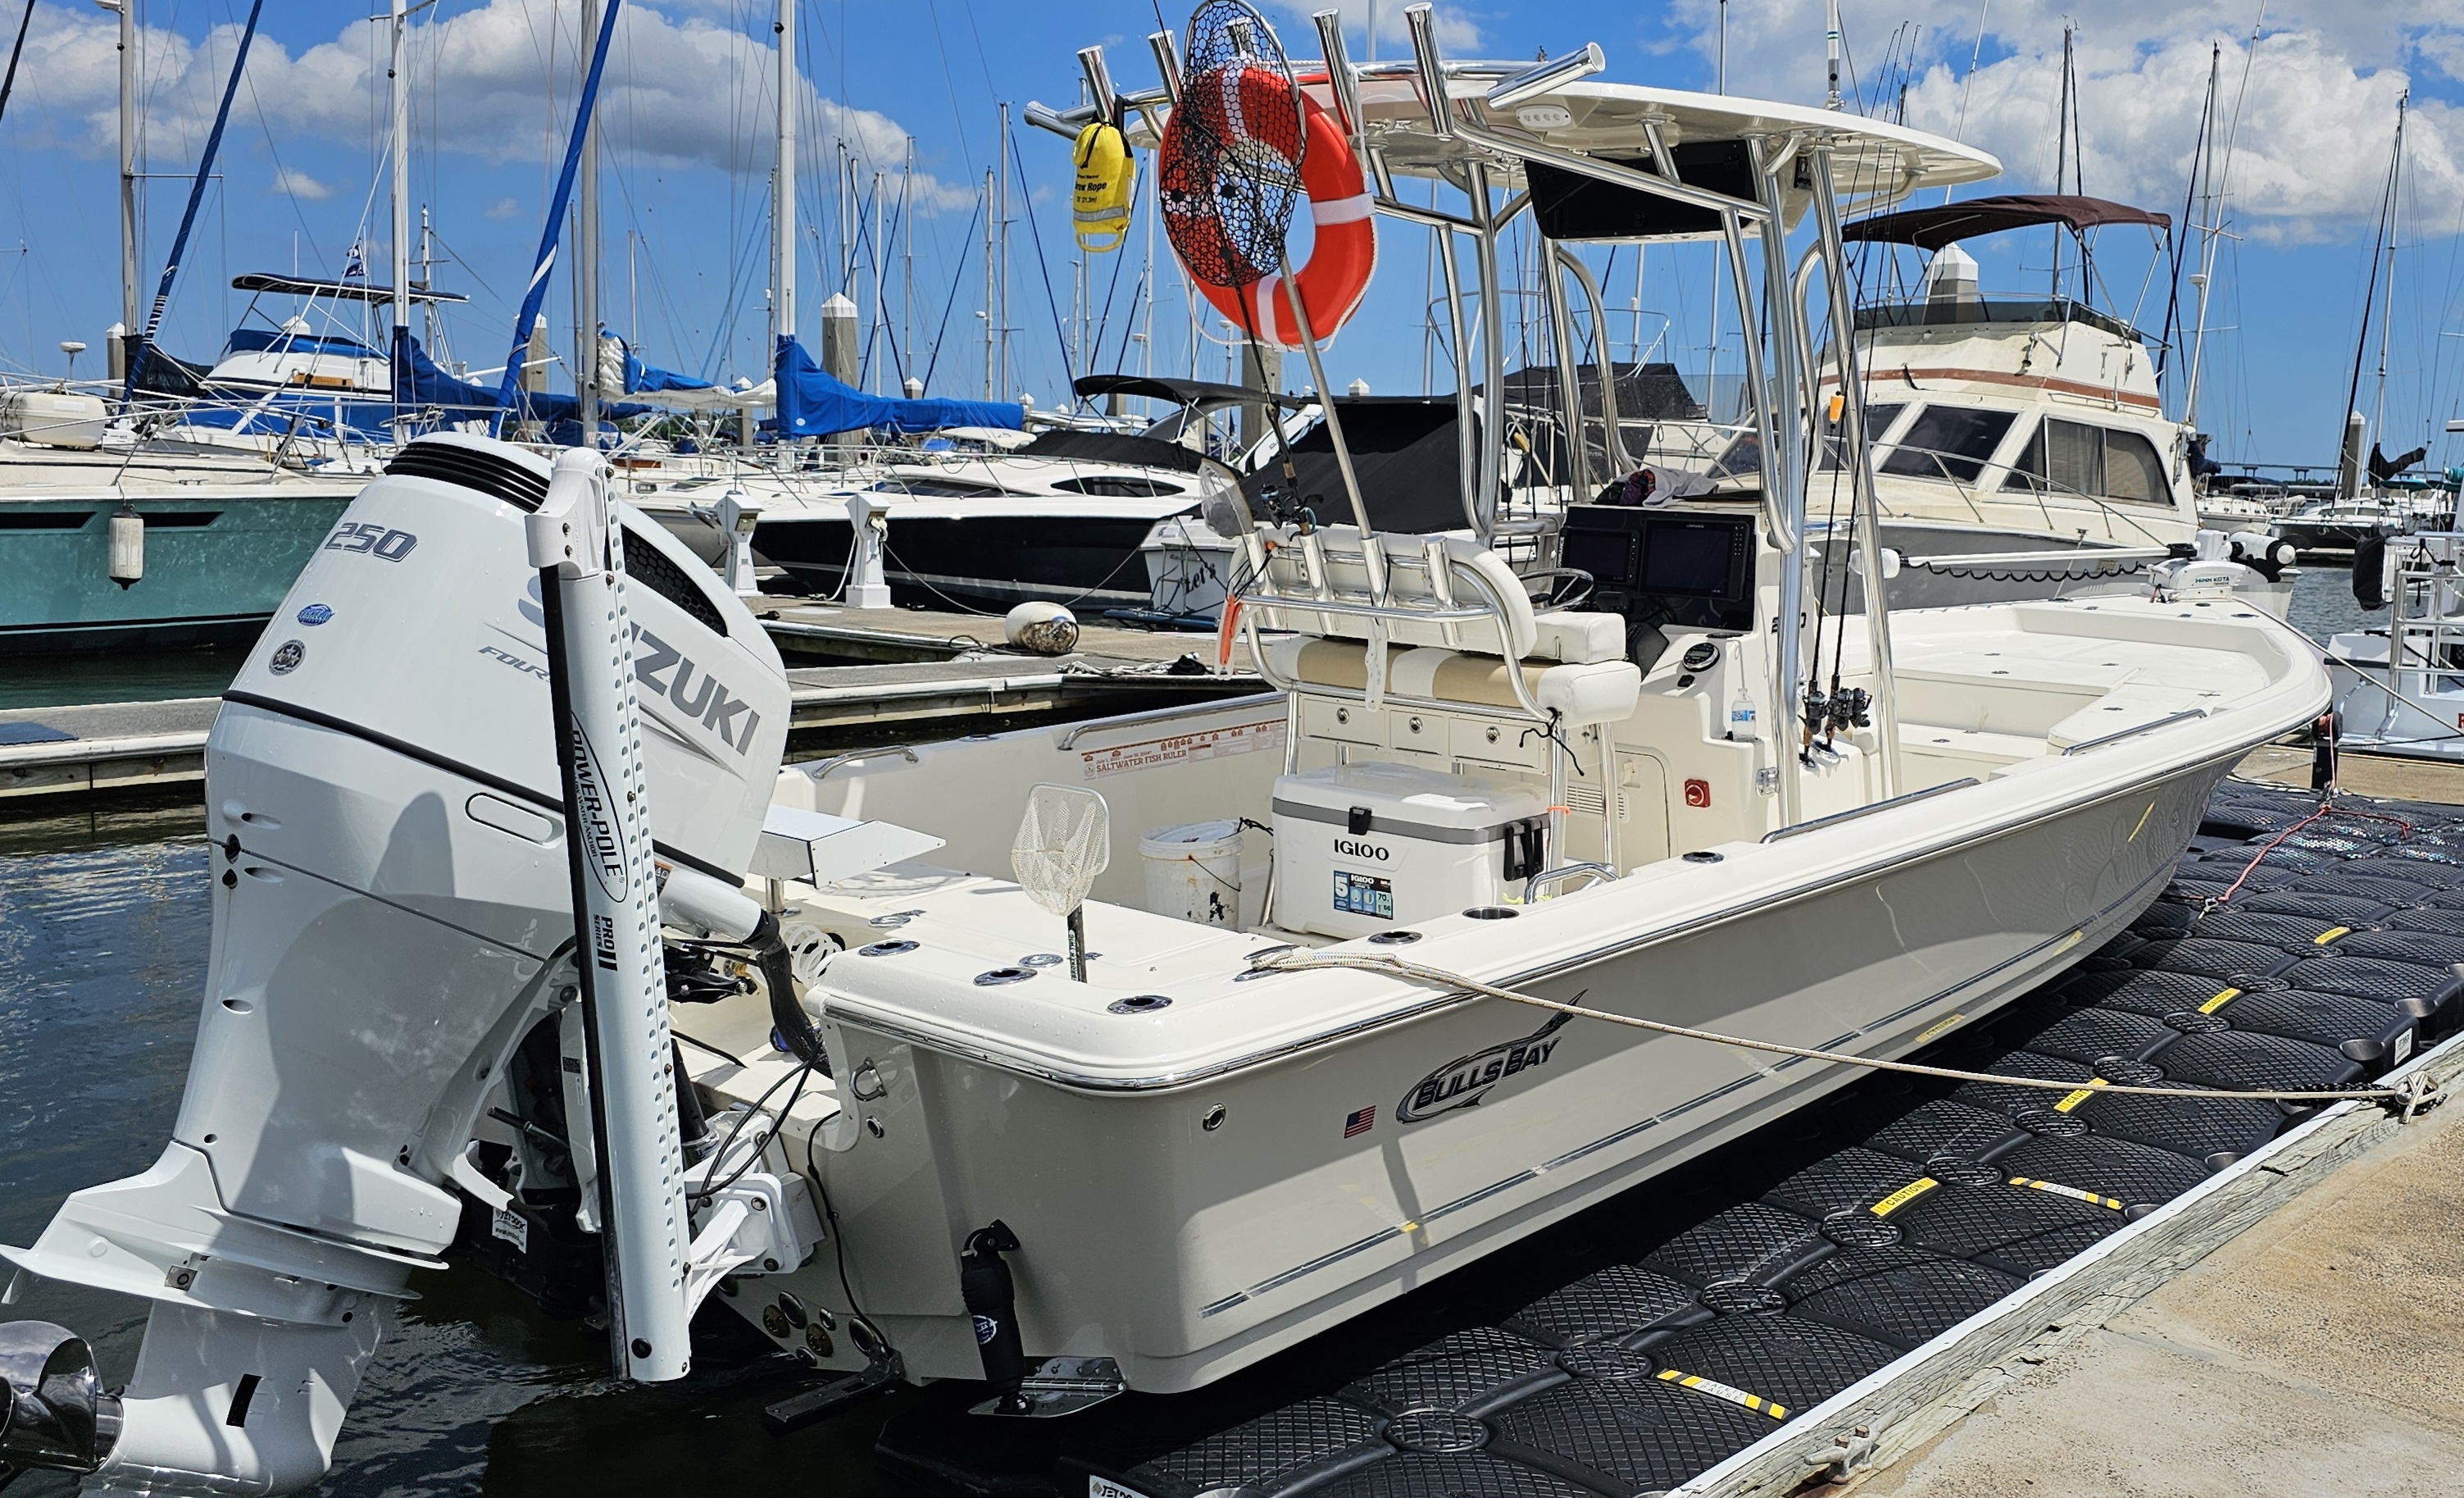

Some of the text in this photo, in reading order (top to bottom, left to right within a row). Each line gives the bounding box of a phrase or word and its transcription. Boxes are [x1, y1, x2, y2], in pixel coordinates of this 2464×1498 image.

[1087, 182, 1107, 192] Rope
[325, 522, 417, 562] 250
[1097, 758, 1143, 772] SALTWATER
[1145, 754, 1162, 764] FISH
[1162, 749, 1187, 760] RULER
[584, 825, 598, 858] ANCHOR
[1334, 839, 1389, 861] IGLOO
[1334, 875, 1349, 897] 5
[1350, 874, 1375, 885] IGLOO
[1377, 892, 1387, 902] 70
[593, 913, 603, 948] SERIES
[601, 916, 616, 953] PRO
[1412, 1036, 1562, 1113] BULLS BAY
[1885, 1183, 1925, 1206] CAUTION
[1699, 1384, 1742, 1401] PAUSE
[1705, 1382, 1746, 1396] SAFETY
